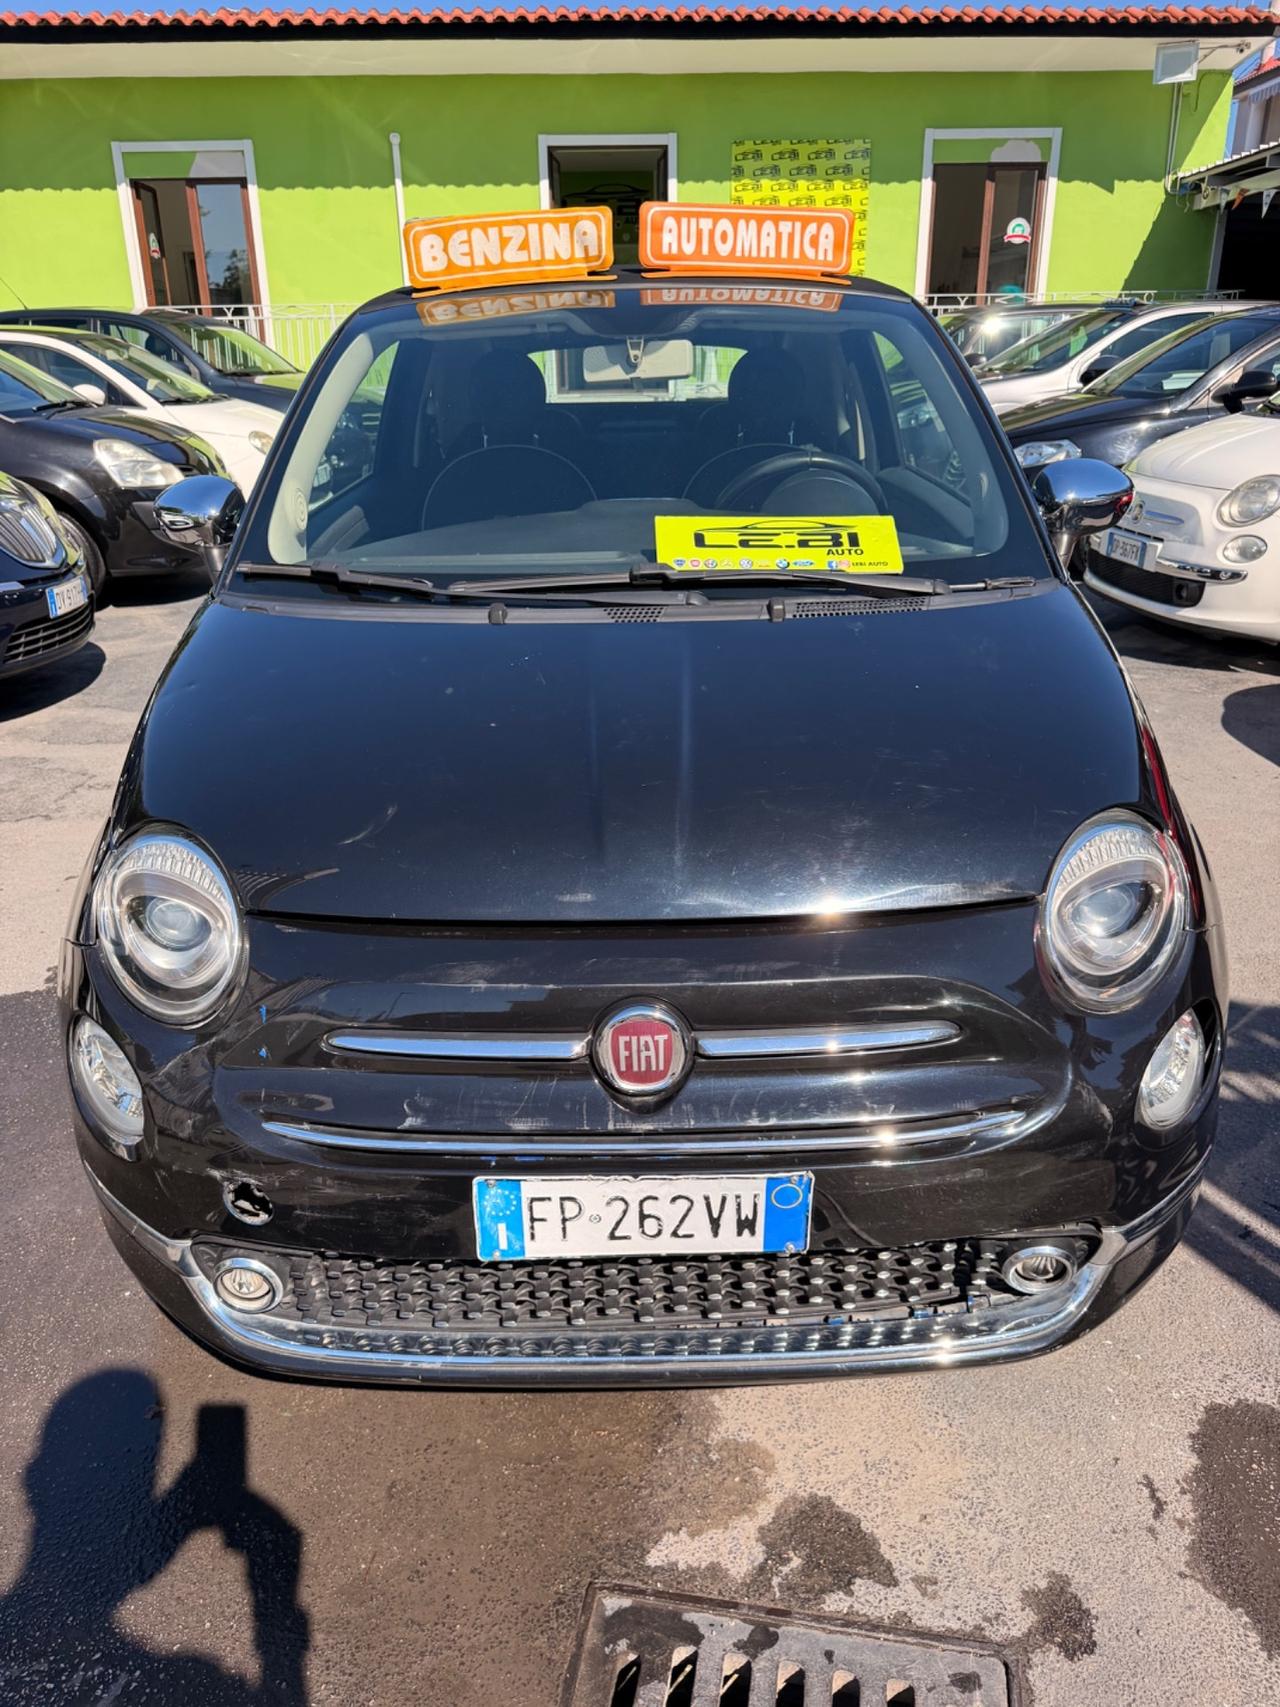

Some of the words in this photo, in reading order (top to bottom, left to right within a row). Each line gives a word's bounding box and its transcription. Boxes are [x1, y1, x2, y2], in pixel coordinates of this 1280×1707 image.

[419, 219, 599, 272] BENZINA
[661, 216, 834, 262] AUTOMATICA
[826, 548, 865, 556] AUTO
[618, 1034, 669, 1072] FIAT
[526, 1194, 584, 1243] FP
[605, 1192, 761, 1242] 262VW
